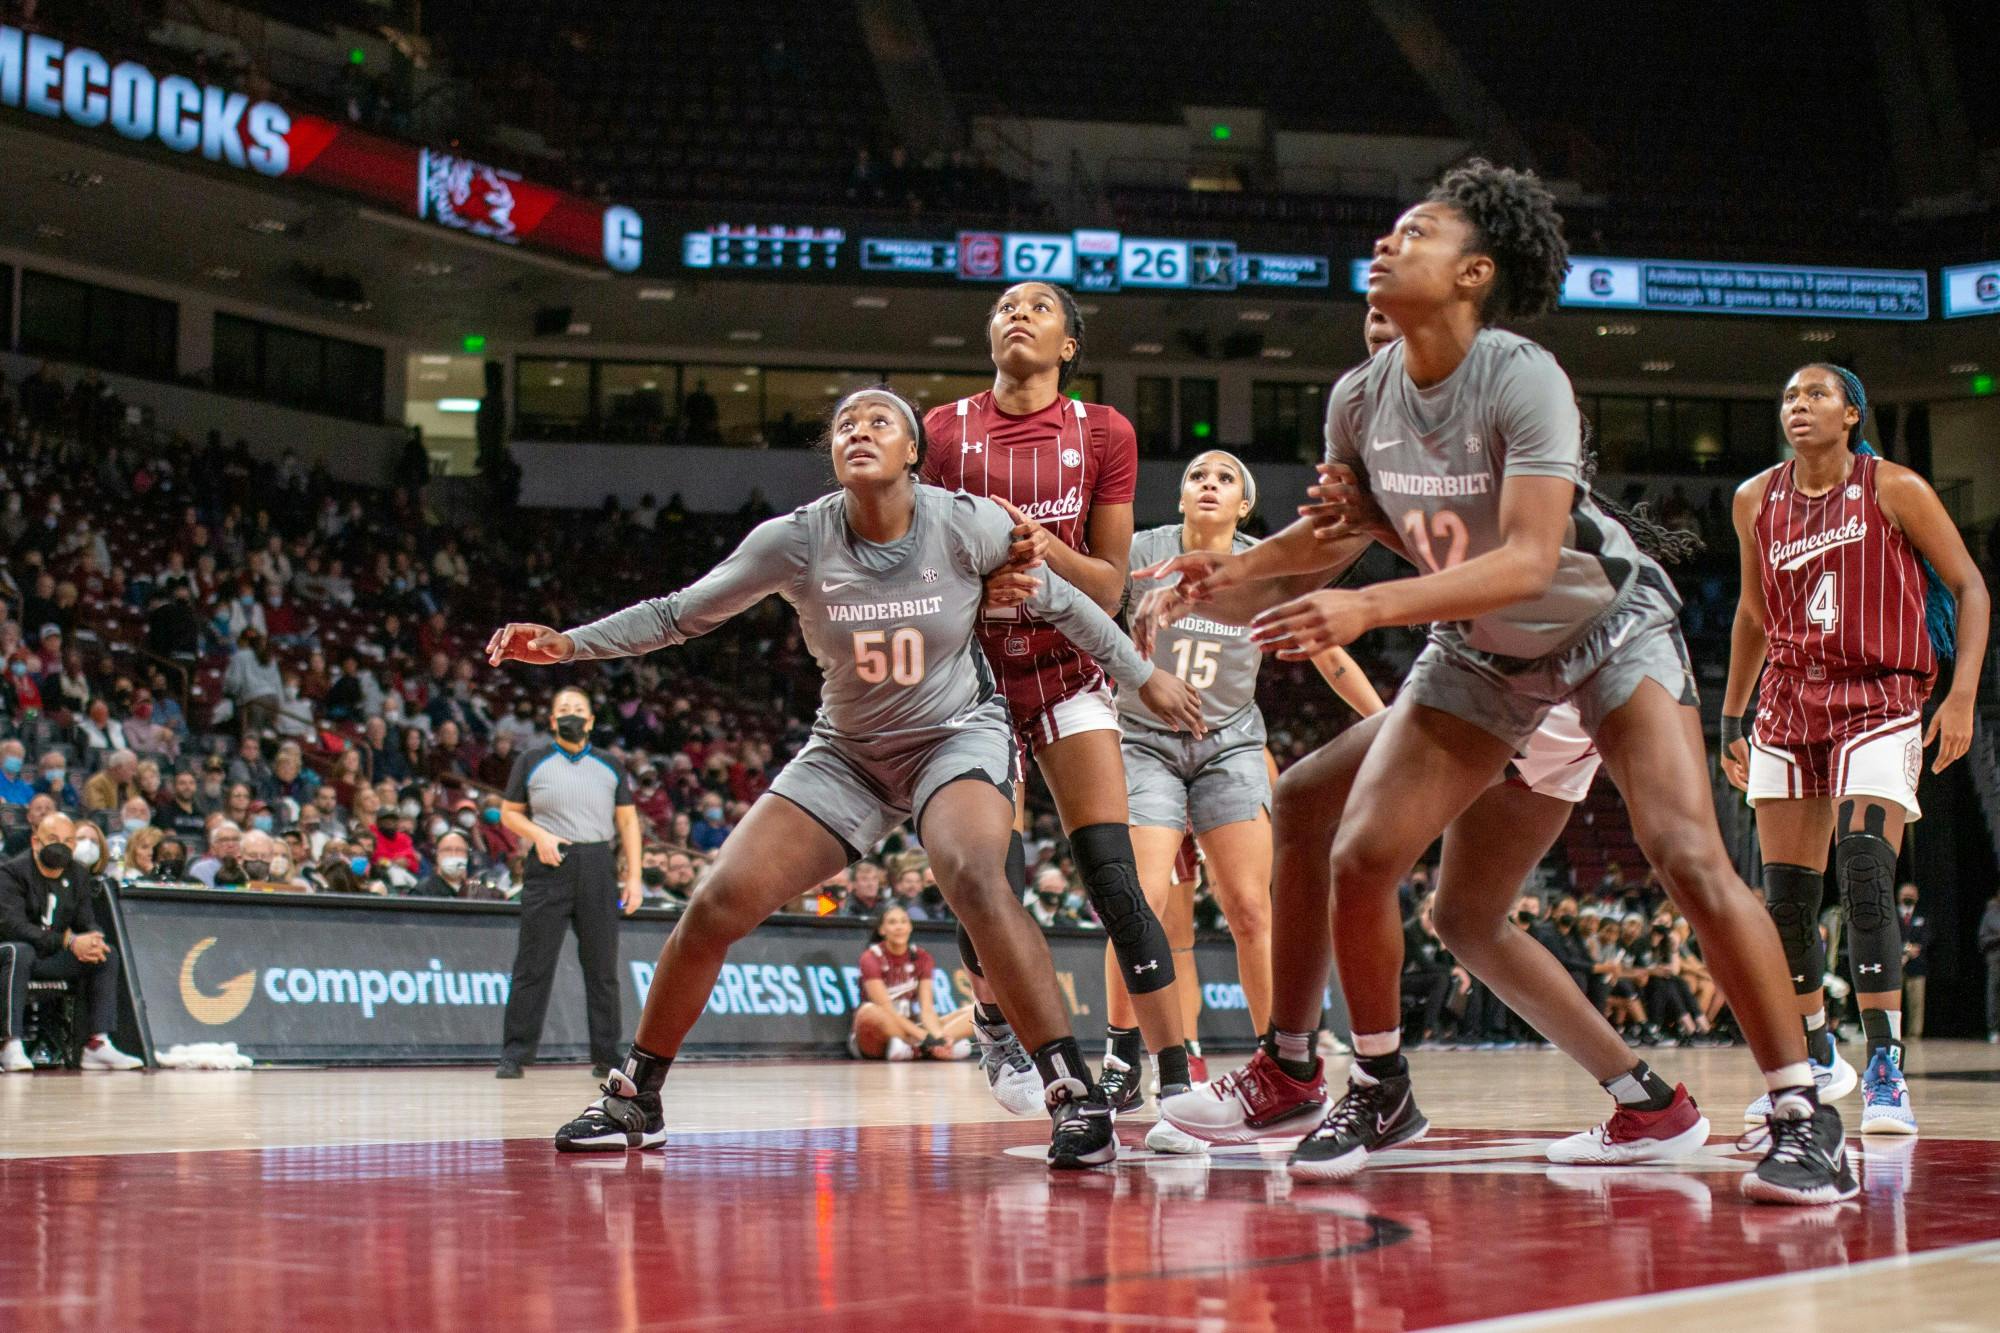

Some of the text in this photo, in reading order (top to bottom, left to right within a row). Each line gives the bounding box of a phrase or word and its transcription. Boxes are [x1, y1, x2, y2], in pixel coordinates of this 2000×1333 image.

[603, 205, 642, 272] G
[1013, 242, 1062, 275] 67
[1131, 247, 1179, 278] 26
[1648, 285, 1704, 305] through
[1725, 291, 1771, 308] games
[1775, 292, 1799, 309] she
[1801, 294, 1813, 309] is
[1815, 294, 1876, 313] shooting
[1736, 272, 1756, 287] the
[1758, 273, 1790, 288] team
[1792, 274, 1804, 289] in
[1806, 275, 1814, 290] 3
[1817, 275, 1848, 293] point
[1062, 449, 1081, 467] SEC
[1378, 470, 1490, 497] VANDERBILT
[1017, 486, 1084, 519] ecocks
[1769, 514, 1868, 571] Gamecocks
[922, 567, 938, 584] SEC
[826, 595, 943, 622] VANDERBILT
[1807, 571, 1839, 634] 4
[1171, 616, 1245, 637] NDERBILT
[852, 627, 925, 687] 50
[1171, 636, 1222, 689] 15
[264, 957, 513, 1018] comporium
[629, 960, 808, 1015] PGRESS
[804, 964, 845, 1015] IS
